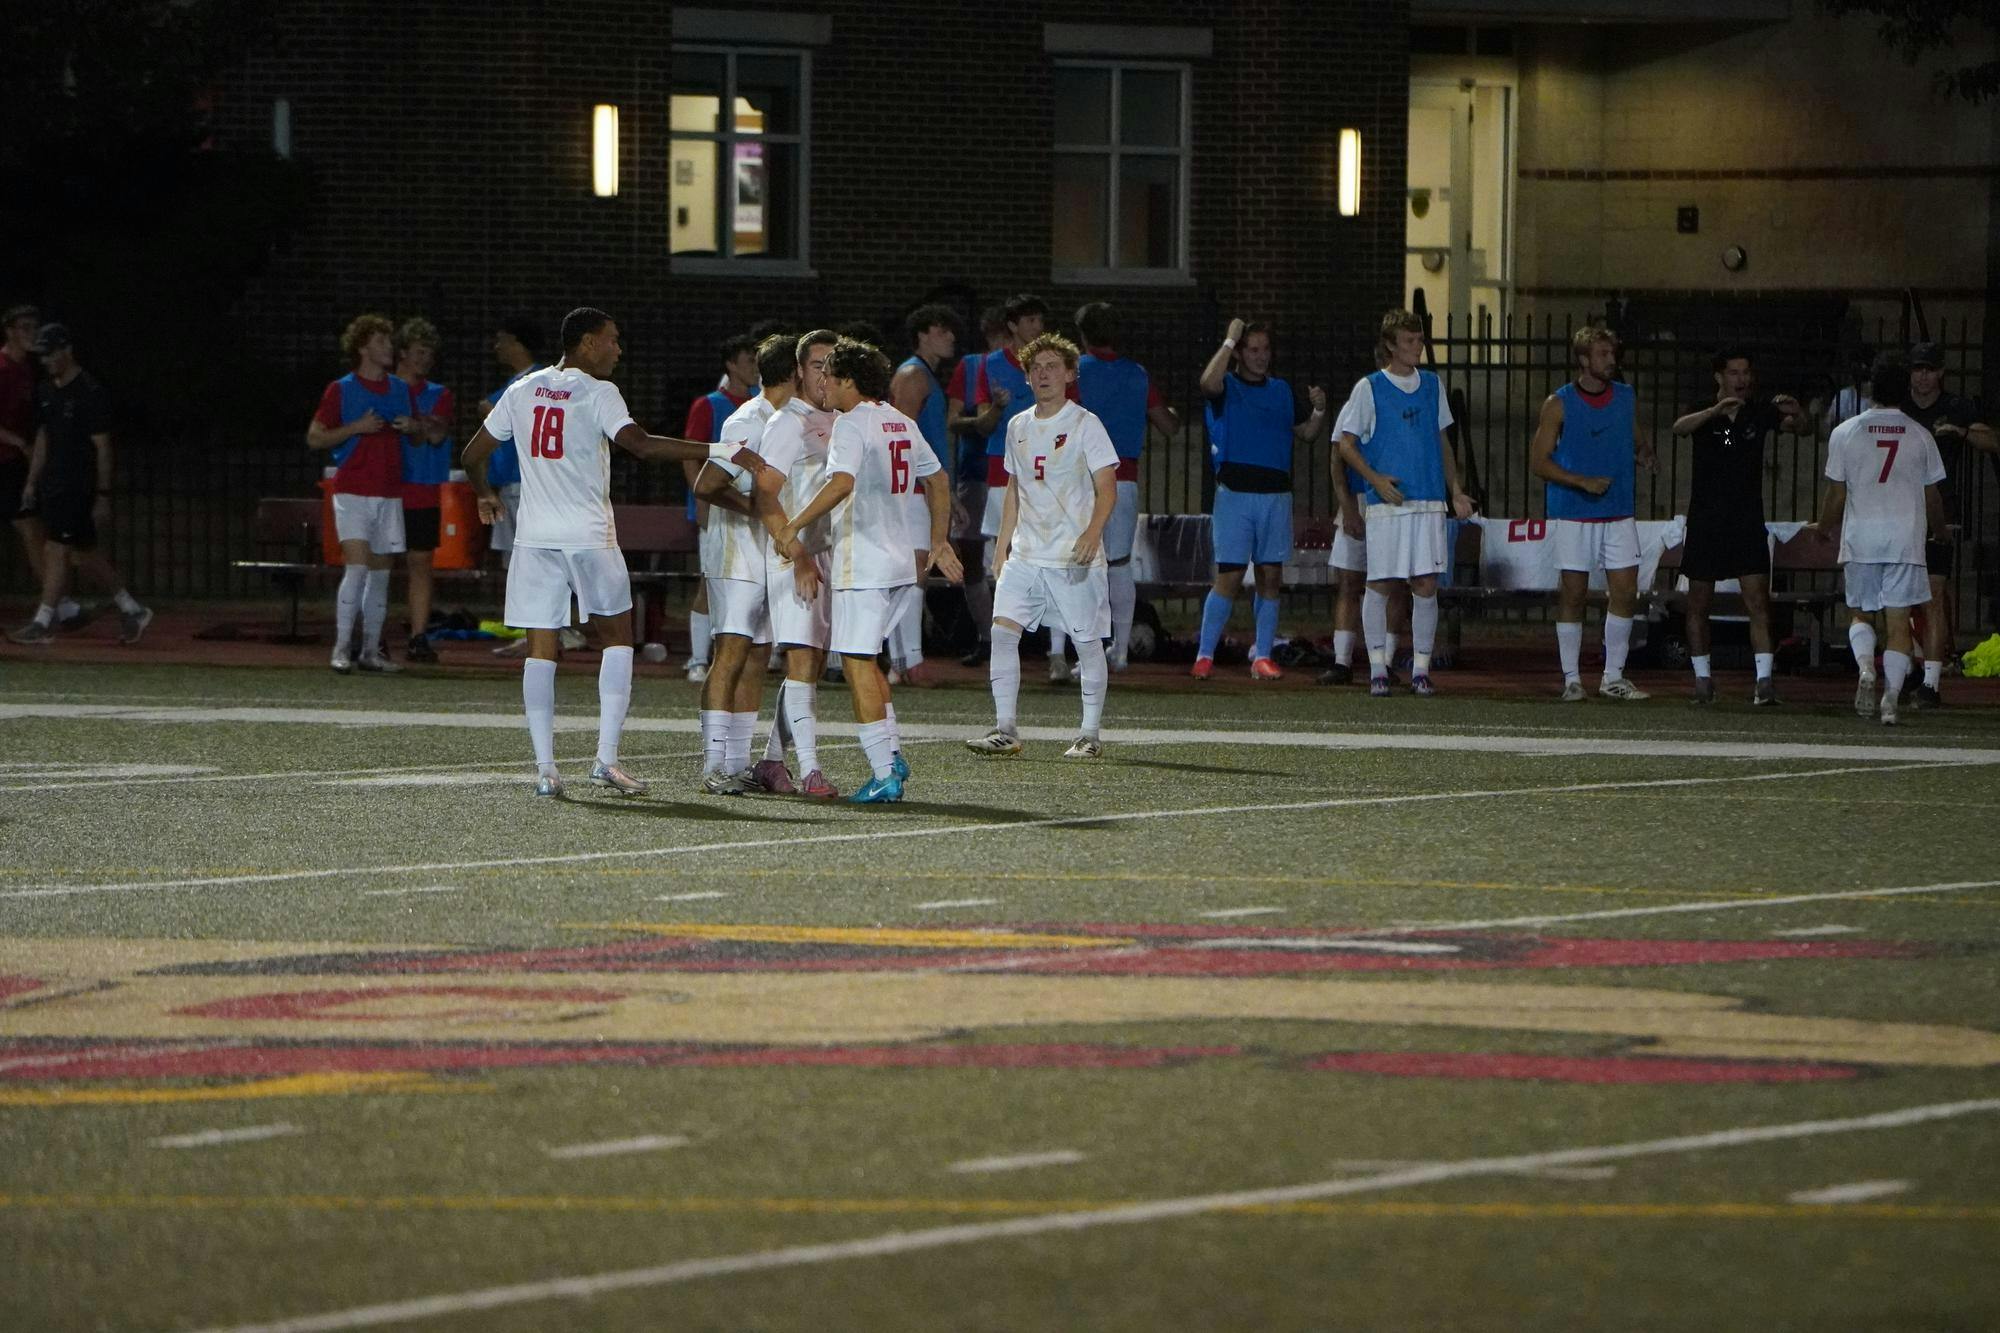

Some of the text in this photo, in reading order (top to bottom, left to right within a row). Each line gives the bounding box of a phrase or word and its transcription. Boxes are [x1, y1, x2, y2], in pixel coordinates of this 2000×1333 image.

[531, 405, 565, 460] 18
[888, 440, 911, 495] 15
[1034, 456, 1046, 481] 5
[1876, 439, 1899, 484] 7
